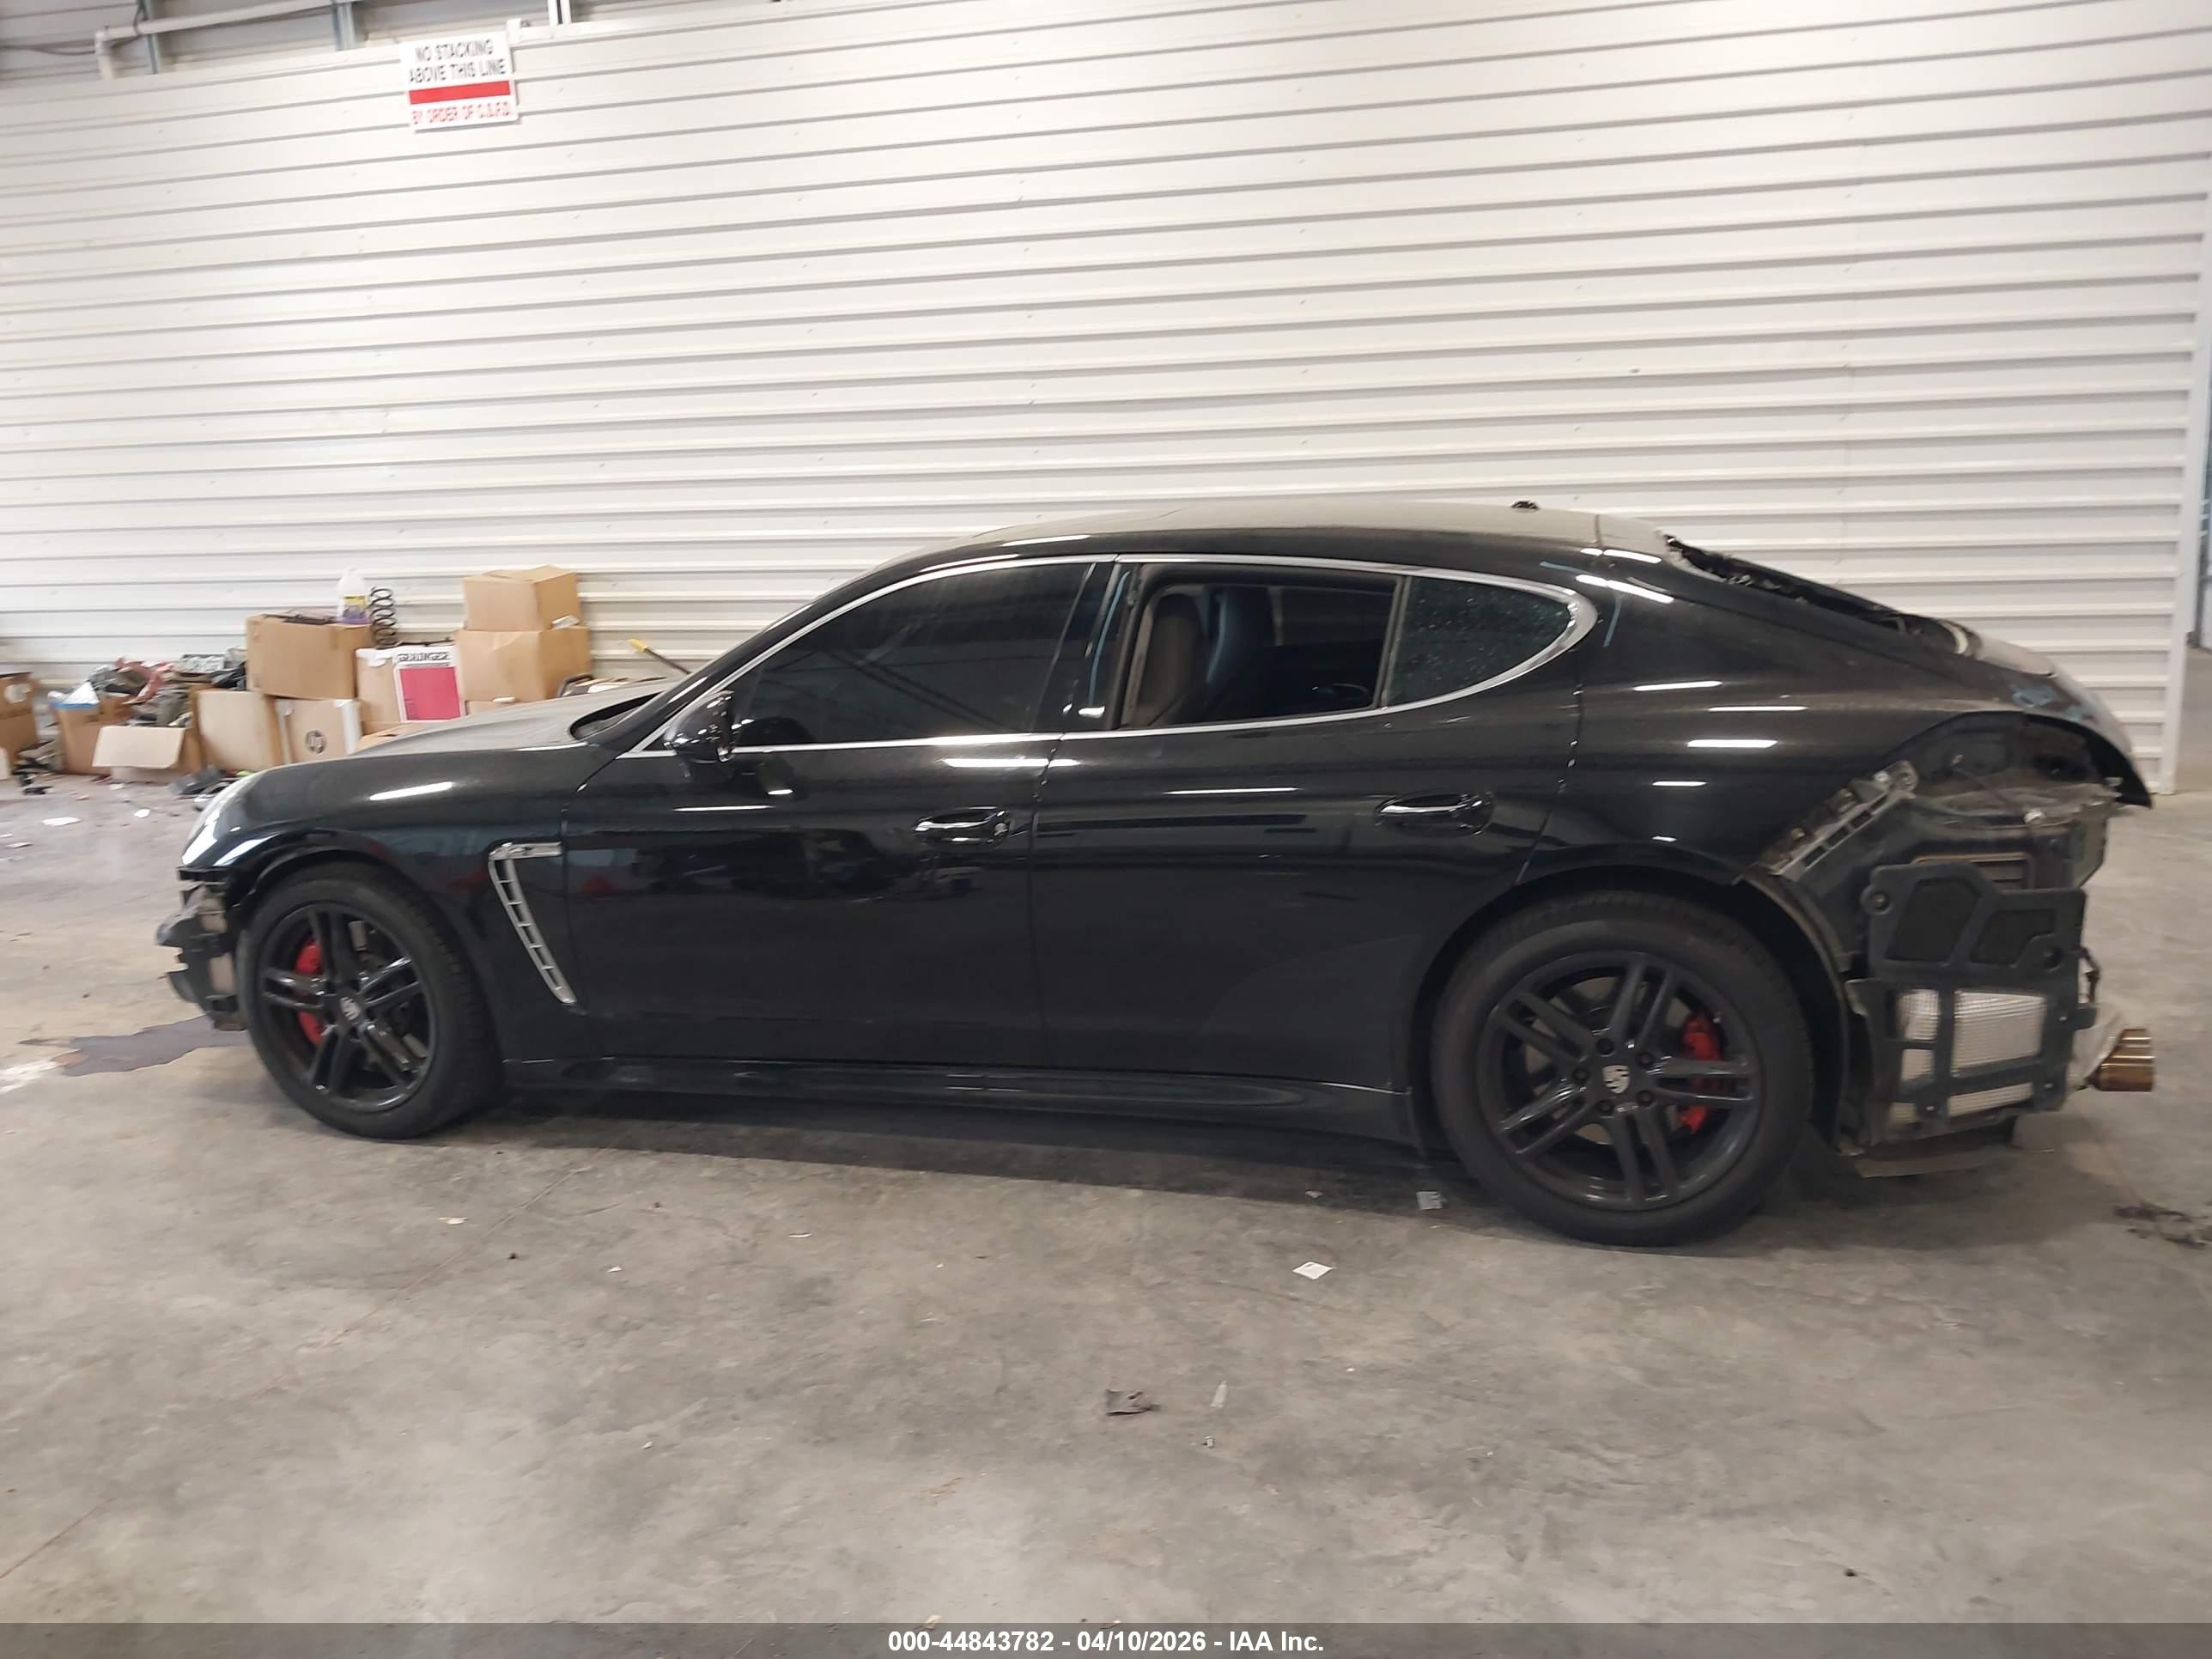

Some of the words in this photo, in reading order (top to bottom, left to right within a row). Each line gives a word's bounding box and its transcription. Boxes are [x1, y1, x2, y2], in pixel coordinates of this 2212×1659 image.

[416, 46, 432, 62] NO
[436, 39, 494, 60] STACKING
[409, 64, 447, 83] ABOVE
[450, 61, 476, 78] THIS
[480, 58, 505, 76] LINE
[411, 110, 423, 125] BY
[428, 106, 459, 123] ORDER
[462, 105, 474, 120] OF
